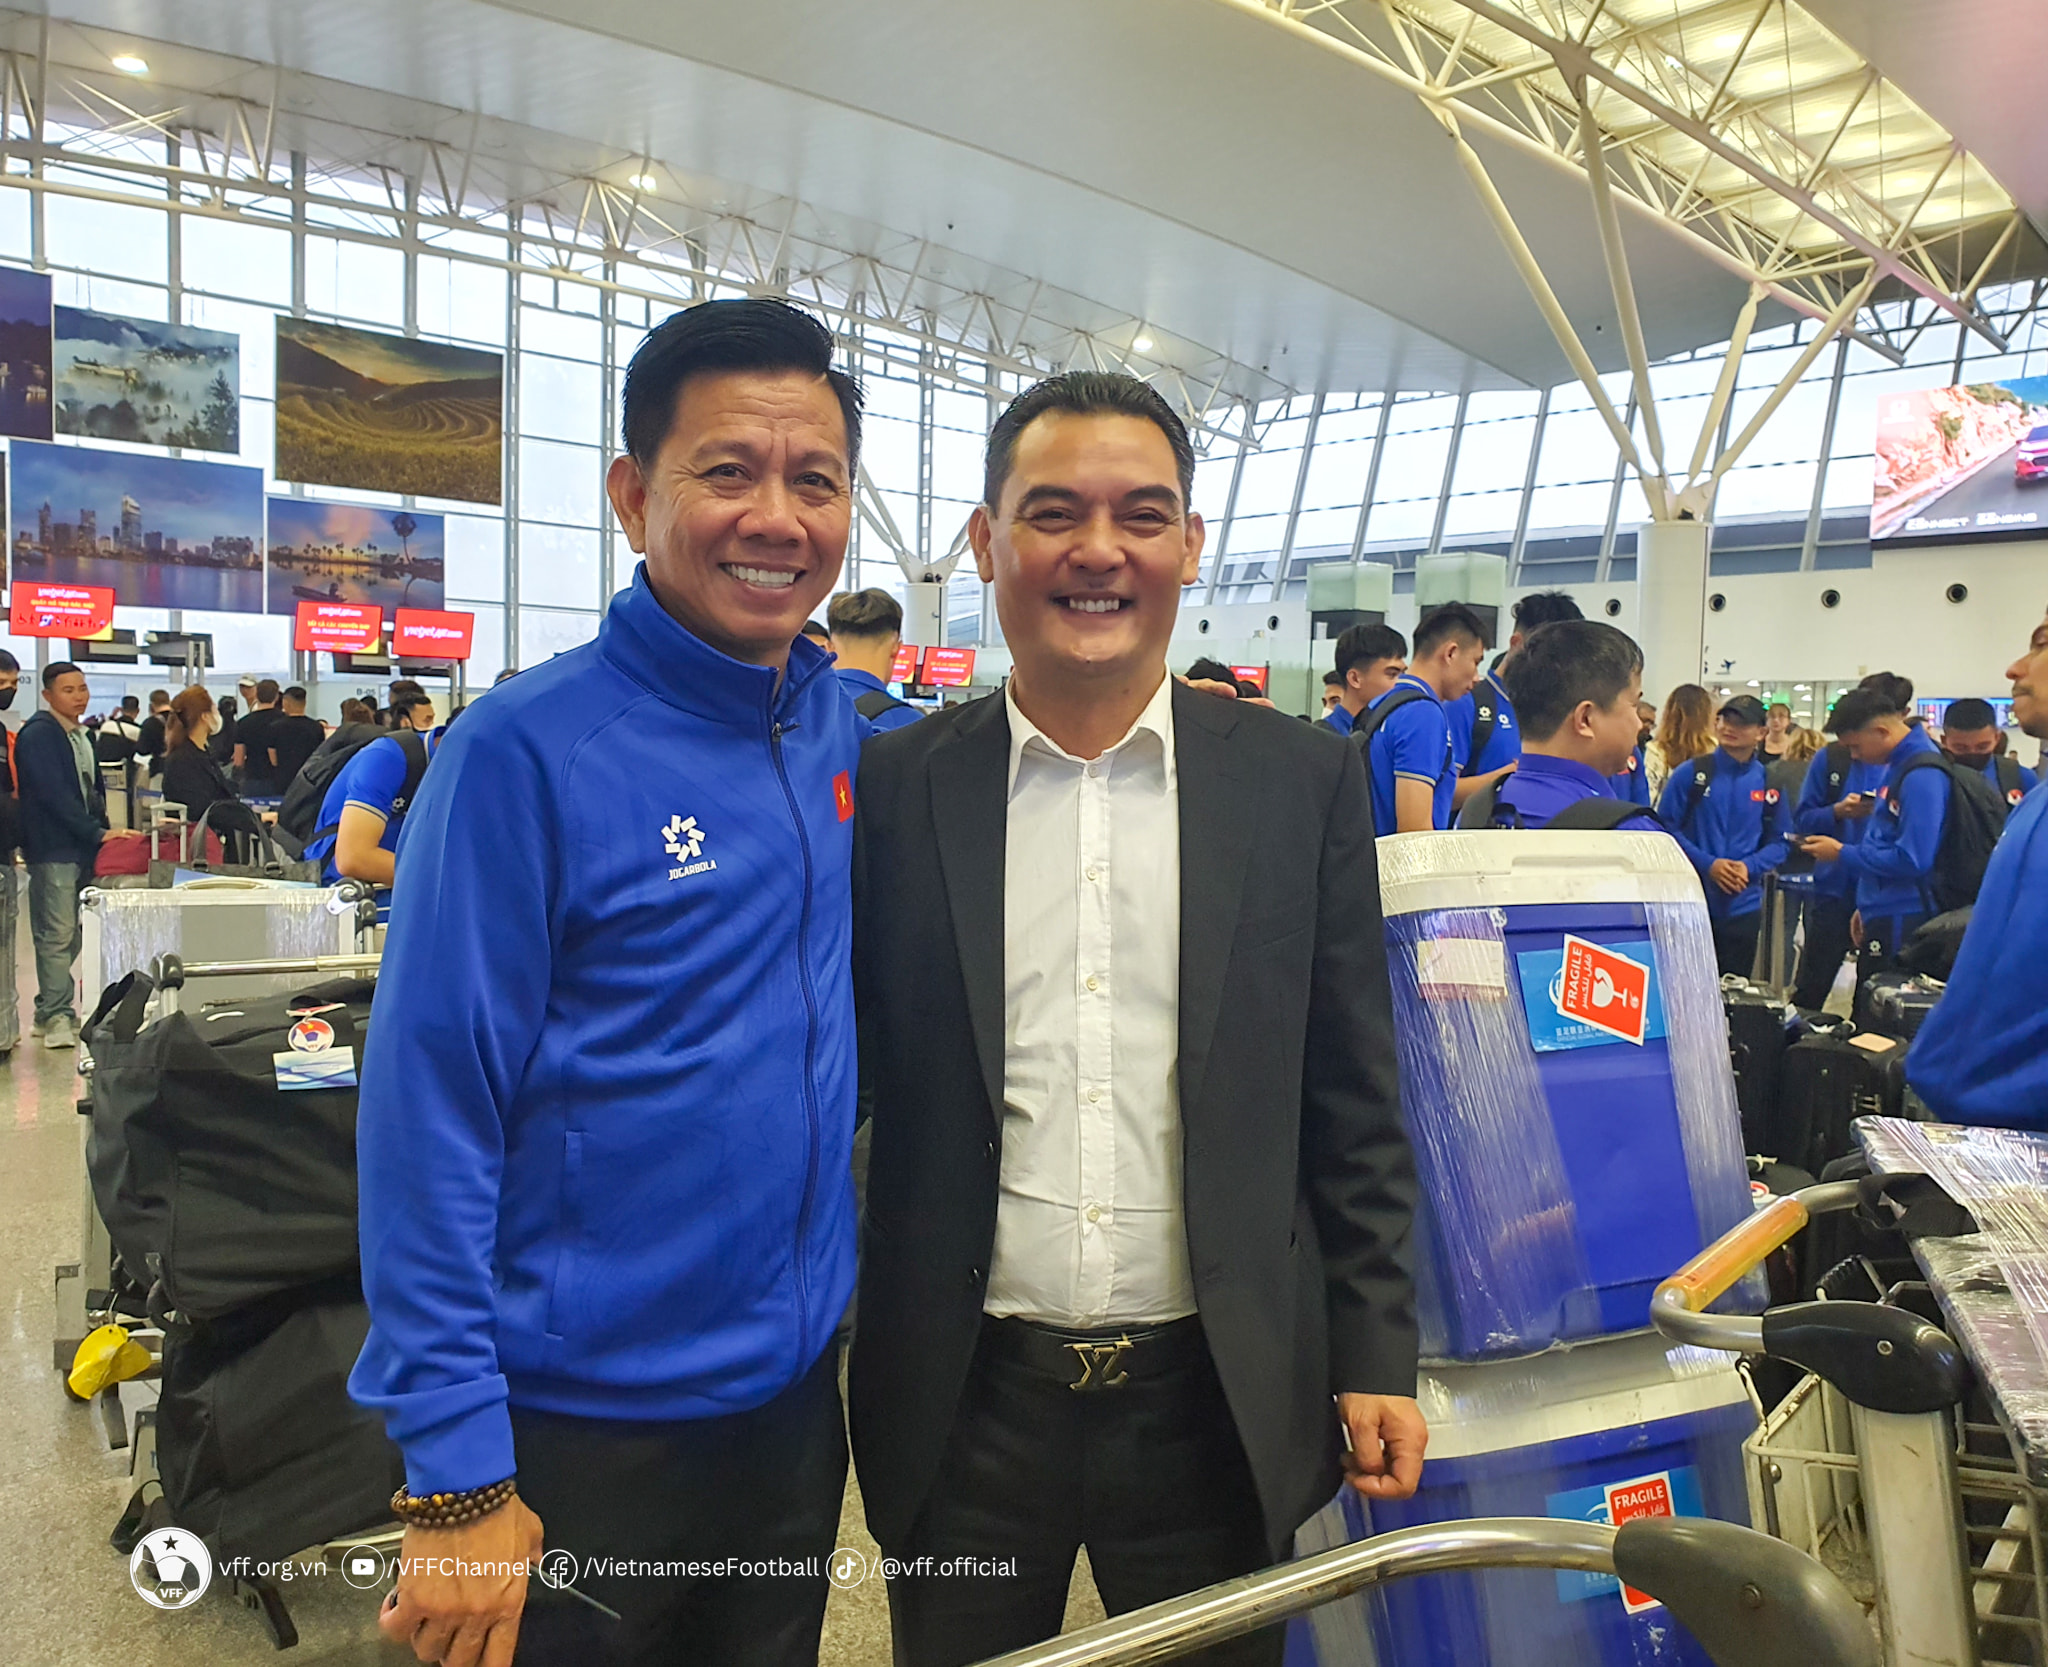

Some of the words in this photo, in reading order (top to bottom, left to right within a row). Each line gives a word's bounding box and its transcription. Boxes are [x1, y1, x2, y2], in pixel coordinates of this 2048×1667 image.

[668, 859, 718, 881] JOGARBOLA
[1566, 946, 1583, 1009] FRAGILE
[1613, 1485, 1665, 1510] FRAGILE
